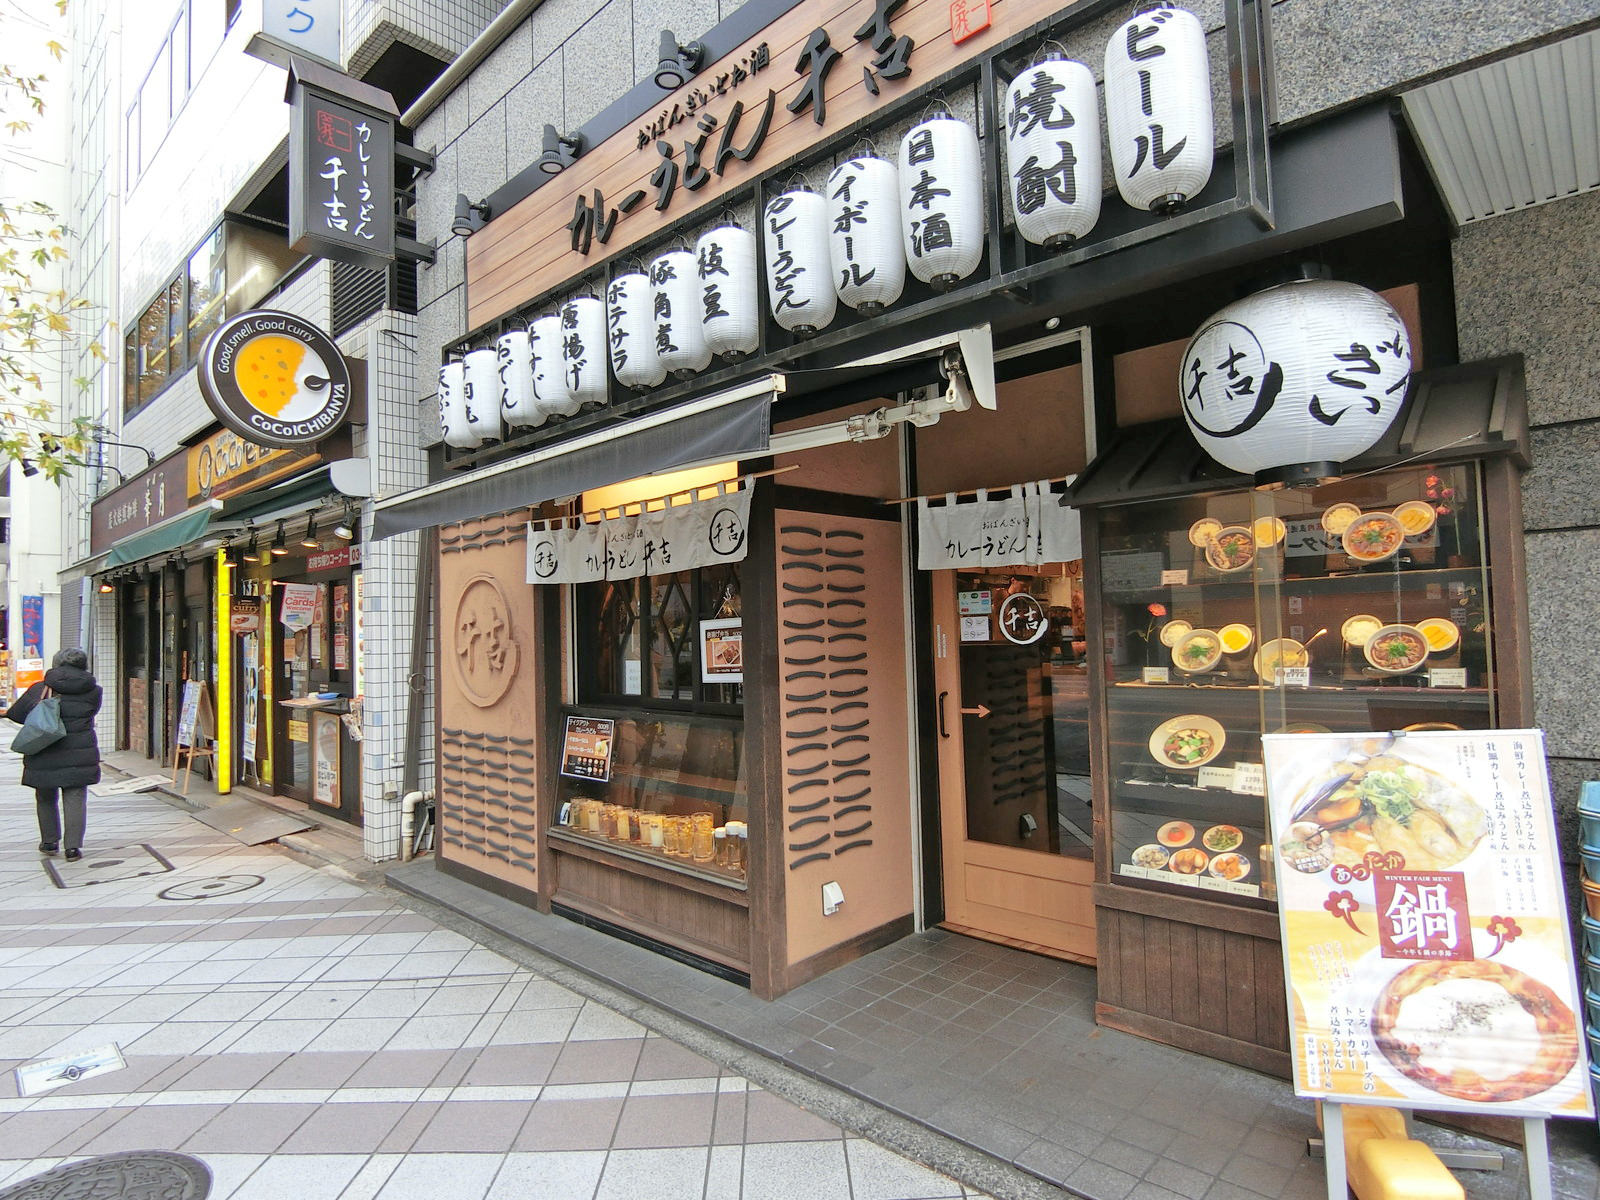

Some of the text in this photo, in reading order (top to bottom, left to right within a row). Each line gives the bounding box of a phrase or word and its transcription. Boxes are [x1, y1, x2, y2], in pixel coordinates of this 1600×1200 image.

[1126, 10, 1188, 180] ビール
[1009, 71, 1076, 215] 焼酎
[319, 156, 348, 232] 千吉
[355, 122, 375, 240] カレーうどん
[908, 129, 953, 258] 日本酒
[766, 197, 812, 315] カレーうどん
[831, 160, 877, 290] ハイボール
[650, 260, 679, 355] 豚角煮
[697, 243, 730, 324] 枝豆
[218, 320, 316, 373] Good smell. Good curry
[561, 303, 585, 391] 唐揚げ
[608, 281, 629, 371] ポテサラ
[498, 338, 518, 409] おでん
[1188, 343, 1254, 411] 千吉
[251, 384, 346, 436] CoCoICHIBANYA
[535, 550, 554, 569] 千吉
[713, 520, 740, 545] 千吉
[233, 605, 258, 613] curry
[285, 597, 315, 606] Cards
[1005, 606, 1039, 631] 千吉
[457, 607, 505, 674] 千吉
[1486, 742, 1510, 851] 牡蠣カレー煮込みうどん
[1513, 741, 1537, 851] 海鮮カレー煮込みうどん
[1335, 854, 1401, 883] あったか
[1385, 883, 1458, 949] 鍋
[1330, 1005, 1344, 1069] 煮込みうどん
[1344, 1006, 1356, 1070] トマトカレー
